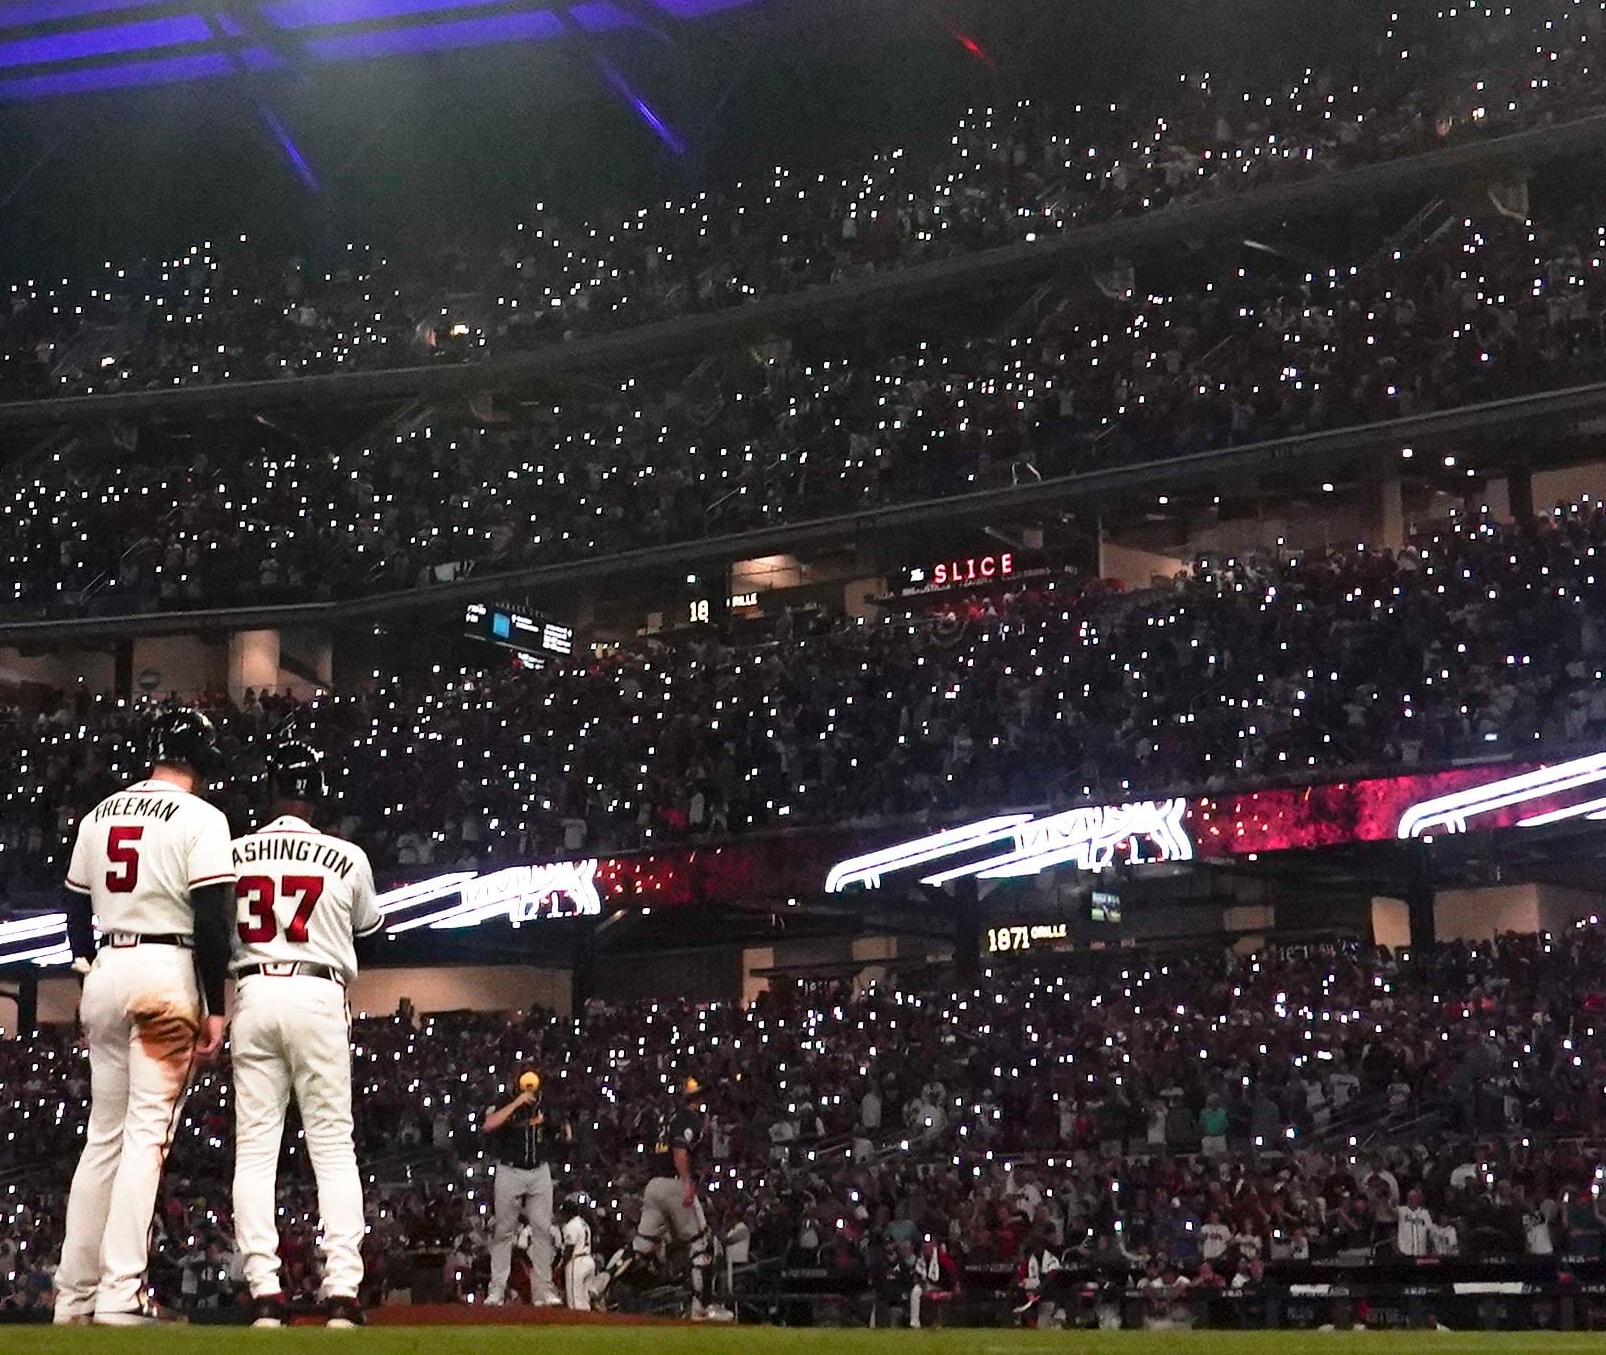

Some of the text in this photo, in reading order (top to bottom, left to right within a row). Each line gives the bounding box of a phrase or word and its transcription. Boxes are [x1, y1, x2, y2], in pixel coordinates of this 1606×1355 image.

[934, 553, 1013, 583] SLICE
[94, 797, 180, 823] FREEMAN
[105, 826, 144, 893] 5
[232, 838, 354, 879] ASHINGTON
[235, 875, 325, 943] 37
[987, 926, 1031, 952] 1871
